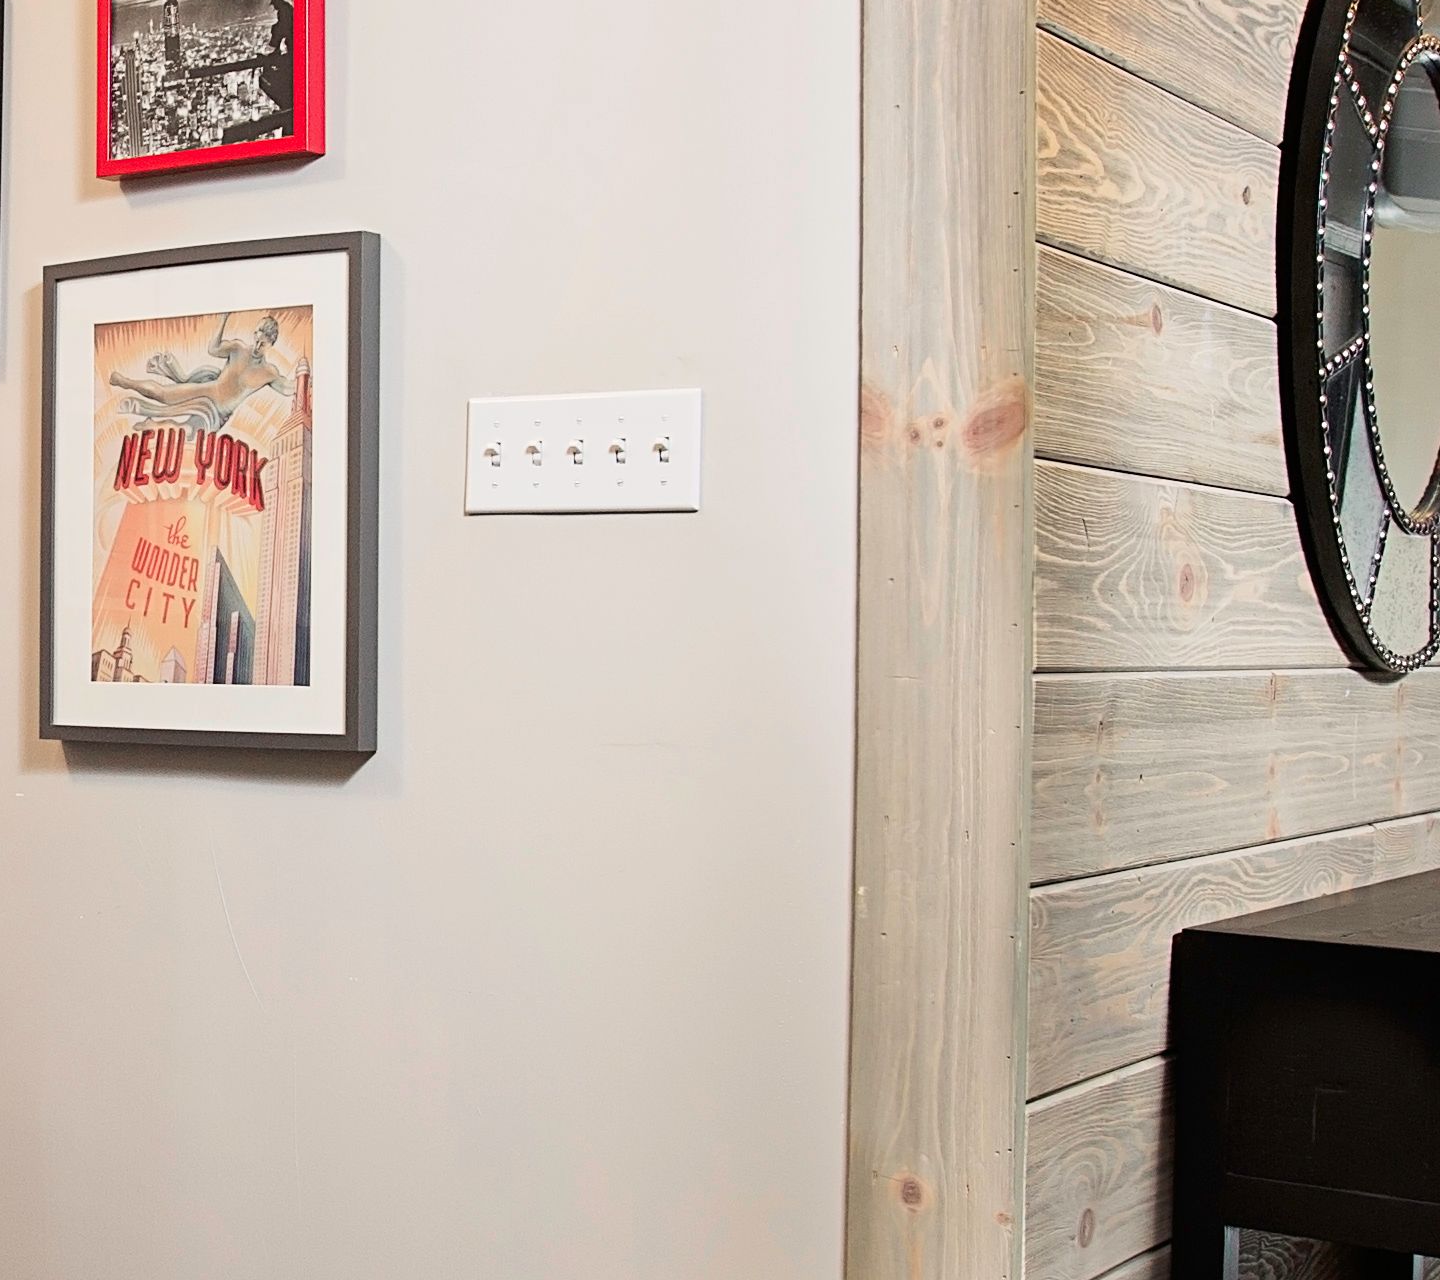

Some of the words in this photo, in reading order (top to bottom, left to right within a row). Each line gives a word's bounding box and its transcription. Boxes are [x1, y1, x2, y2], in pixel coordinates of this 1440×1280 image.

[115, 427, 186, 491] NEW
[194, 428, 269, 512] YORK
[162, 516, 191, 549] the
[131, 536, 199, 592] WONDER
[125, 578, 196, 628] CITY
